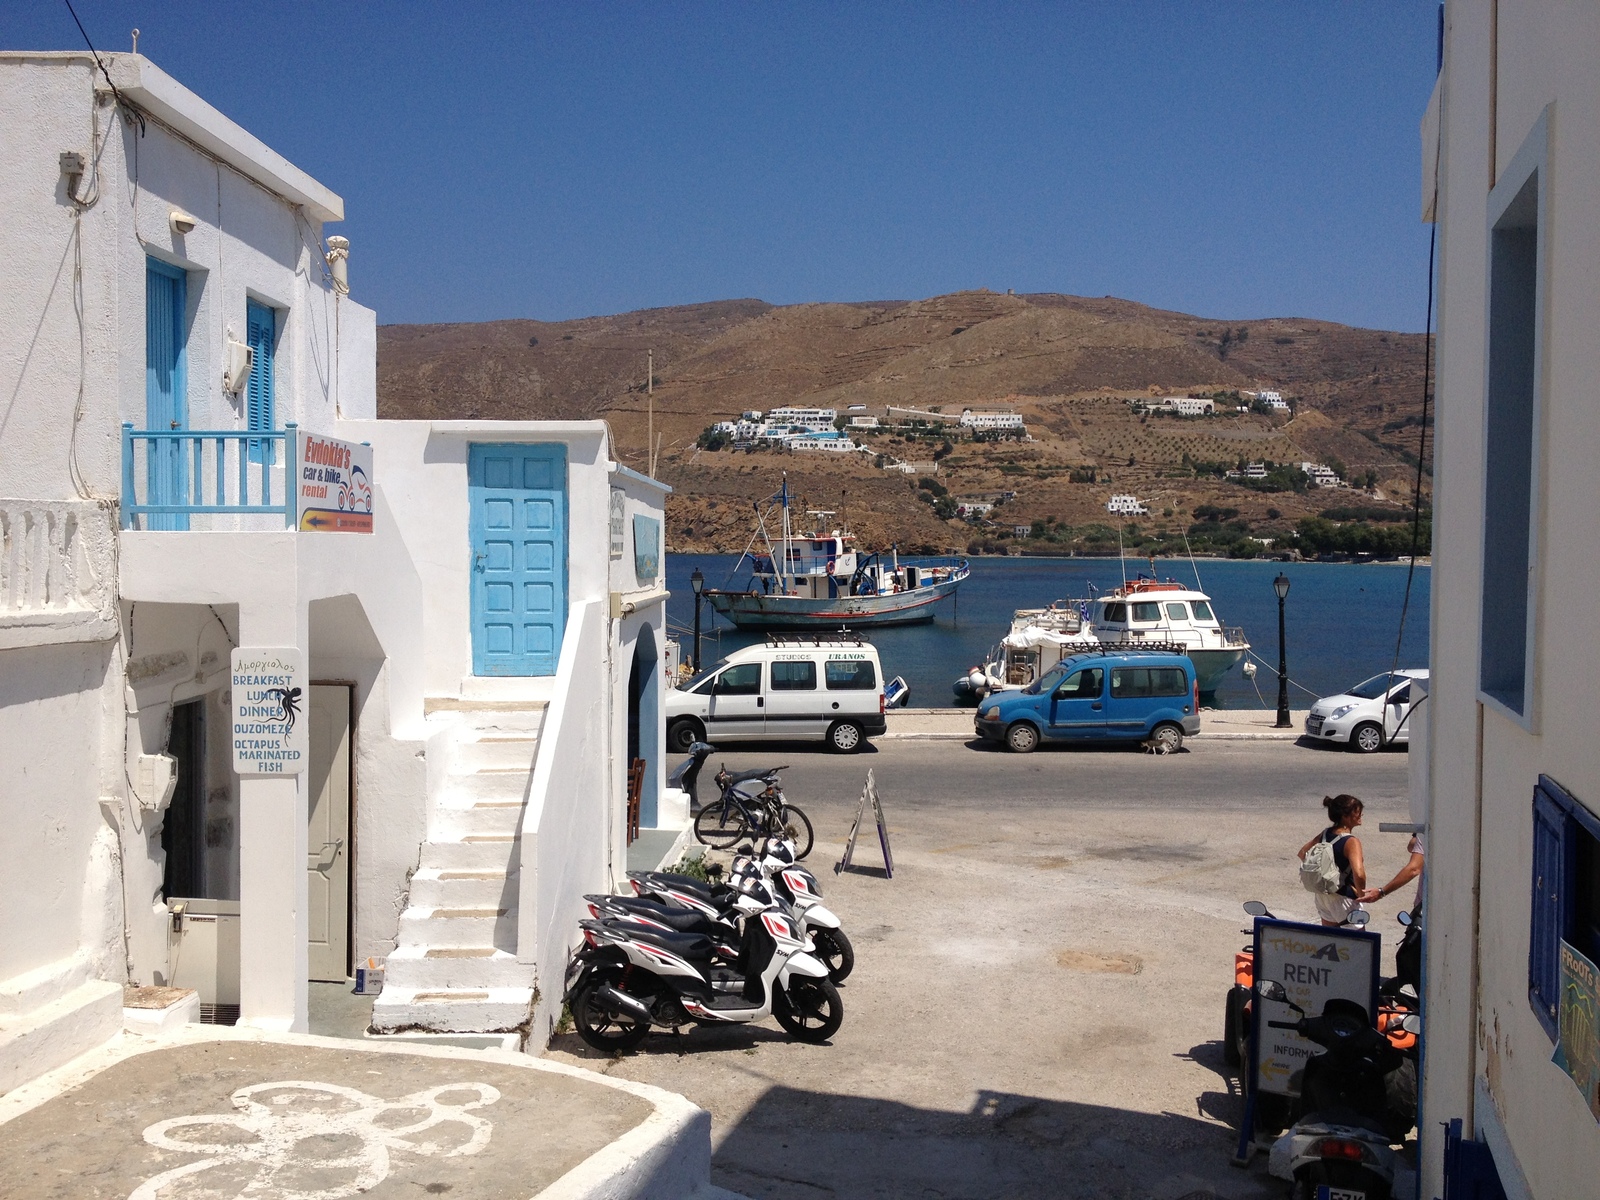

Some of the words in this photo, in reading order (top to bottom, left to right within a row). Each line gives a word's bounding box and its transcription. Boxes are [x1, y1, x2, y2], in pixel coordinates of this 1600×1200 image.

[304, 436, 351, 469] Evdokia's
[303, 466, 317, 481] car
[317, 469, 324, 482] &
[324, 467, 341, 484] bike
[301, 484, 328, 499] rental
[829, 653, 866, 661] URANOS
[233, 675, 292, 686] BREAKFAST
[247, 690, 282, 701] LUNCH
[239, 706, 283, 717] DINNER
[234, 724, 293, 735] OUZOMEZE
[234, 739, 281, 750] OCTAPUS
[239, 750, 301, 760] MARINATED
[258, 762, 283, 773] FISH
[776, 948, 790, 958] SYM
[1269, 938, 1350, 962] THOMAS
[1284, 963, 1332, 987] RENT
[1272, 1062, 1291, 1070] HERE
